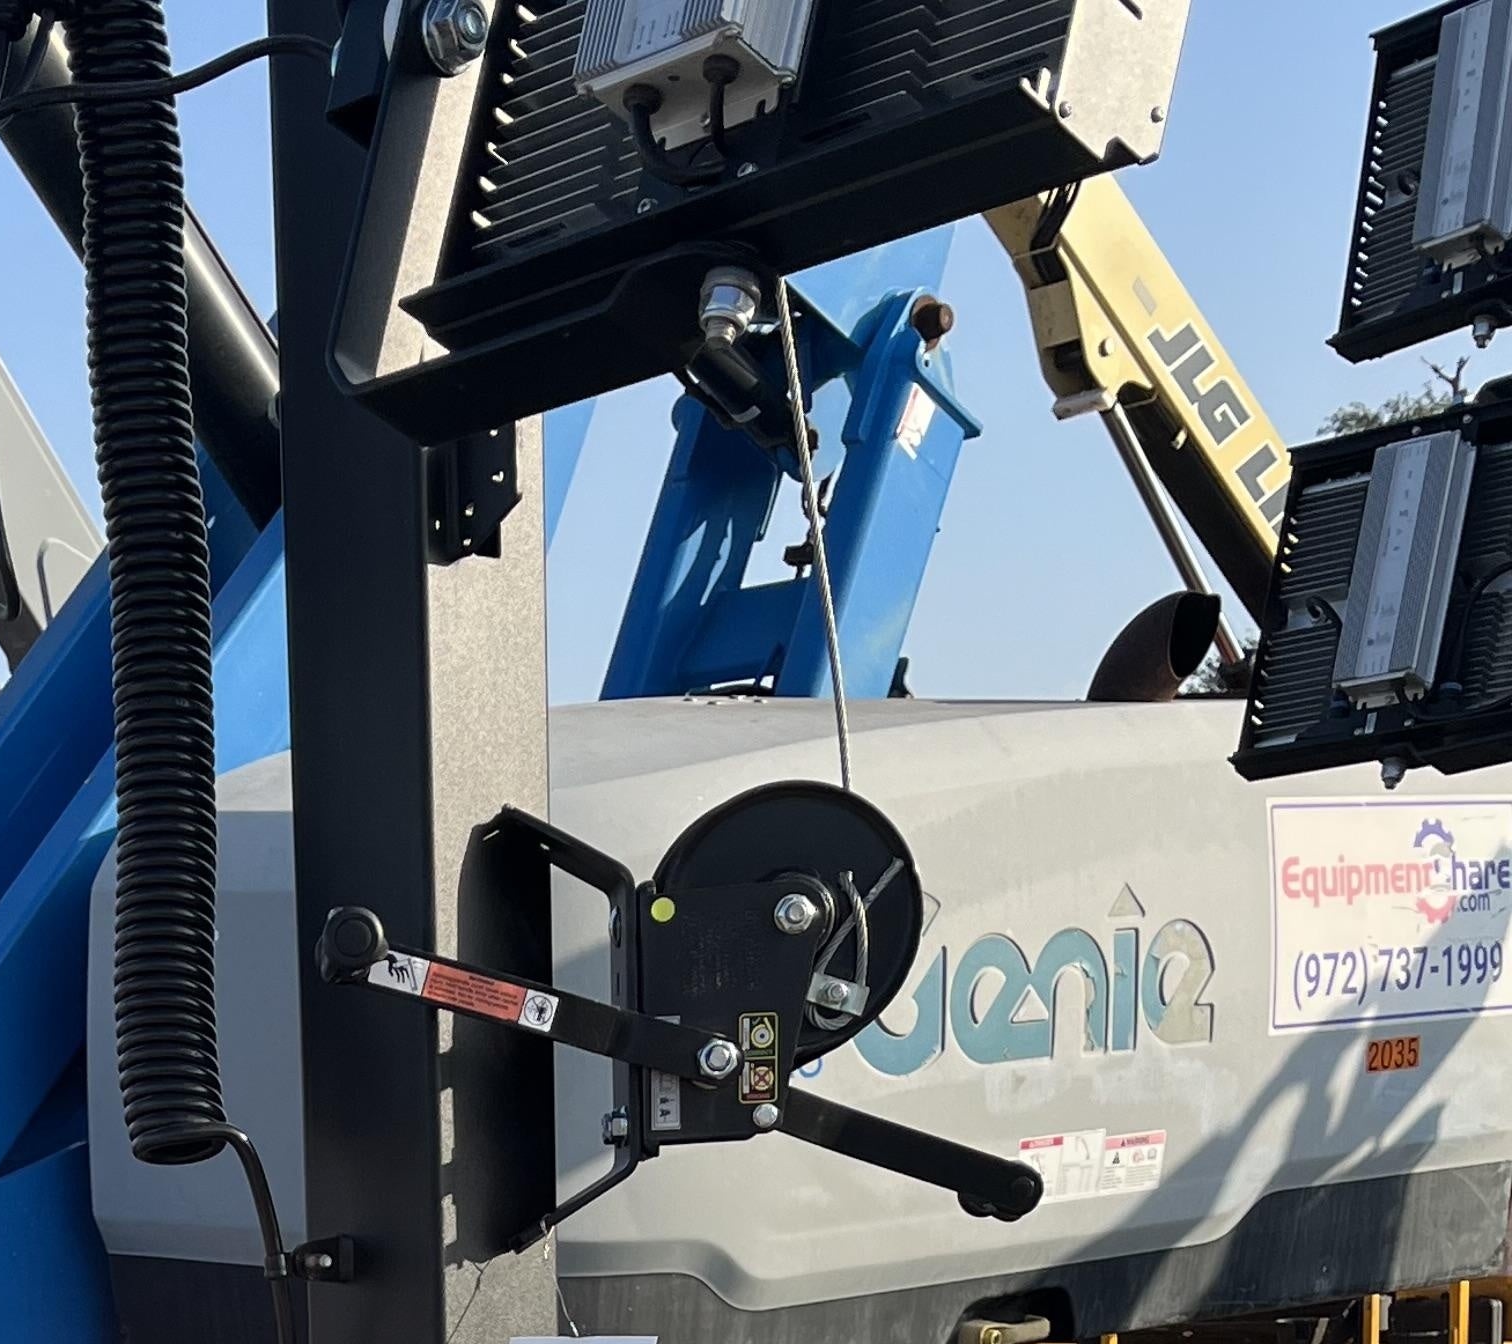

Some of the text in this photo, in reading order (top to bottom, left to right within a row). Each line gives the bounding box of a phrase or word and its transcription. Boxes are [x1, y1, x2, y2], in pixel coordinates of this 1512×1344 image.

[1147, 322, 1252, 446] JLG
[1294, 940, 1504, 1010] (972) 737-1999
[1367, 1038, 1419, 1072] 2035
